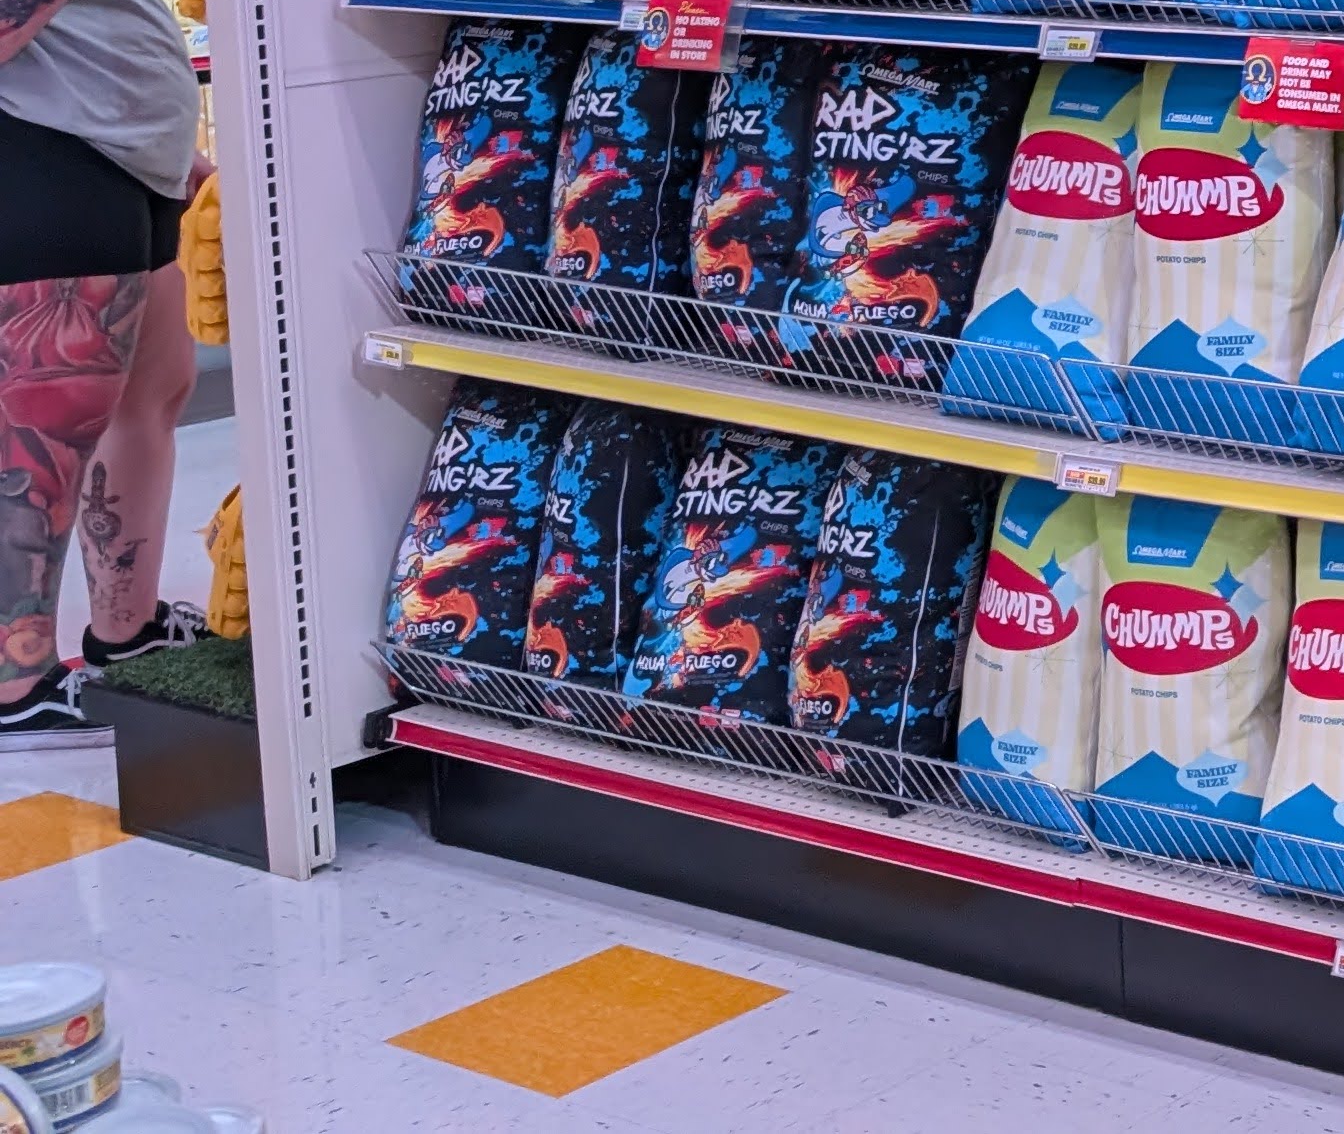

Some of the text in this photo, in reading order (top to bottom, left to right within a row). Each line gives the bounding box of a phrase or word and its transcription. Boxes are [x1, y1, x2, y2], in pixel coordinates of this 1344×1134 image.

[676, 16, 689, 25] NO
[673, 28, 686, 36] OR
[672, 39, 713, 49] DRINKING
[670, 50, 707, 60] IN STORE
[1282, 56, 1330, 68] FOOD AND
[1281, 67, 1332, 79] DRINK MAY
[1279, 78, 1311, 88] NOT BE
[1278, 89, 1341, 102] CONSUMED IN
[815, 87, 895, 129] RAD
[1277, 99, 1341, 113] OMEGA MART.
[813, 129, 959, 163] STING'RZ
[917, 170, 948, 183] CHIPS
[793, 299, 828, 318] AQUA
[852, 303, 917, 320] FUEGO
[680, 447, 750, 488] RAD
[672, 488, 800, 517] STING'RZ
[684, 653, 737, 671] FUEGO
